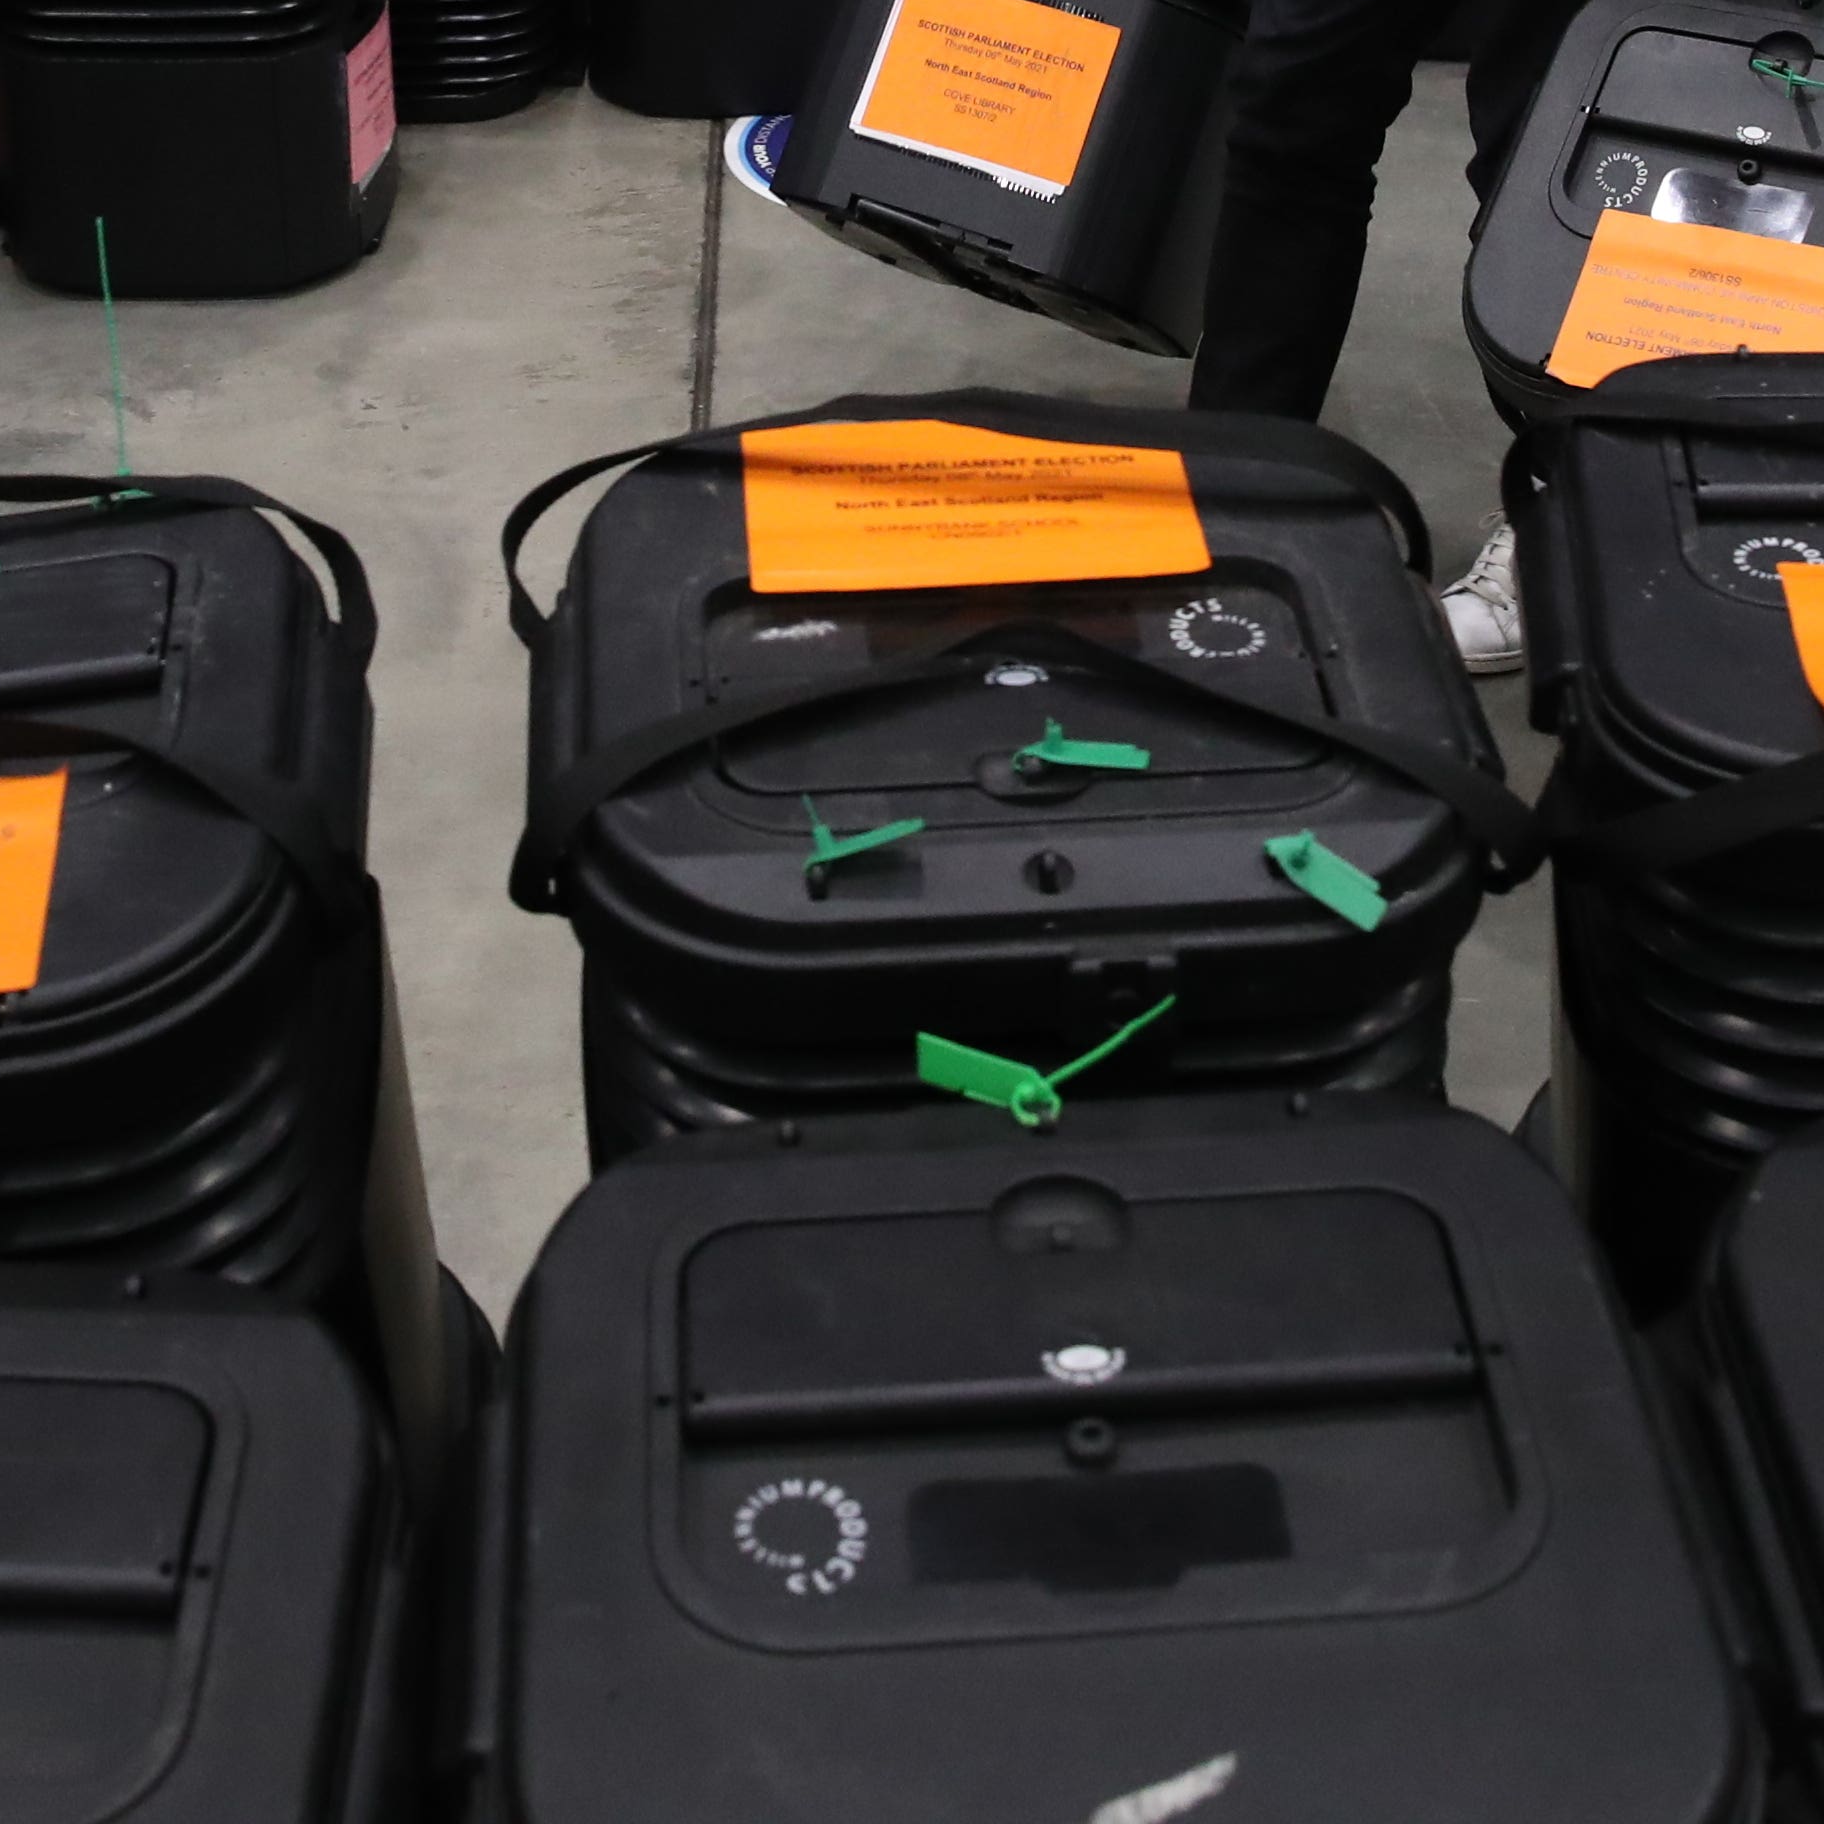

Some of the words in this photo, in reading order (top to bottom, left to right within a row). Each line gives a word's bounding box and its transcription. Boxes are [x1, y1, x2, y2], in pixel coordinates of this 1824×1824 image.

[917, 18, 966, 40] SCOTTISH
[967, 31, 1032, 56] PARLIAMENT
[1032, 49, 1086, 73] ELECTION
[943, 37, 984, 61] Thursday
[1004, 54, 1024, 69] May
[1024, 60, 1048, 74] 2021
[924, 58, 950, 74] North
[951, 65, 973, 79] East
[975, 71, 1016, 91] Scotland
[1017, 83, 1053, 102] Region
[943, 88, 972, 103] COVE
[973, 95, 1016, 116] LIBRARY
[1623, 296, 1664, 313] Region
[1666, 304, 1717, 322] Scotland
[1720, 315, 1747, 329] East
[1748, 320, 1782, 335] North
[1585, 331, 1645, 351] ELECTION
[790, 462, 893, 476] SCOTTISH
[898, 457, 1027, 473] PARLIAMENT
[1033, 453, 1135, 467] ELECTION
[835, 500, 889, 511] North
[894, 497, 938, 508] East
[944, 494, 1030, 507] Scotland
[1033, 491, 1105, 504] Region
